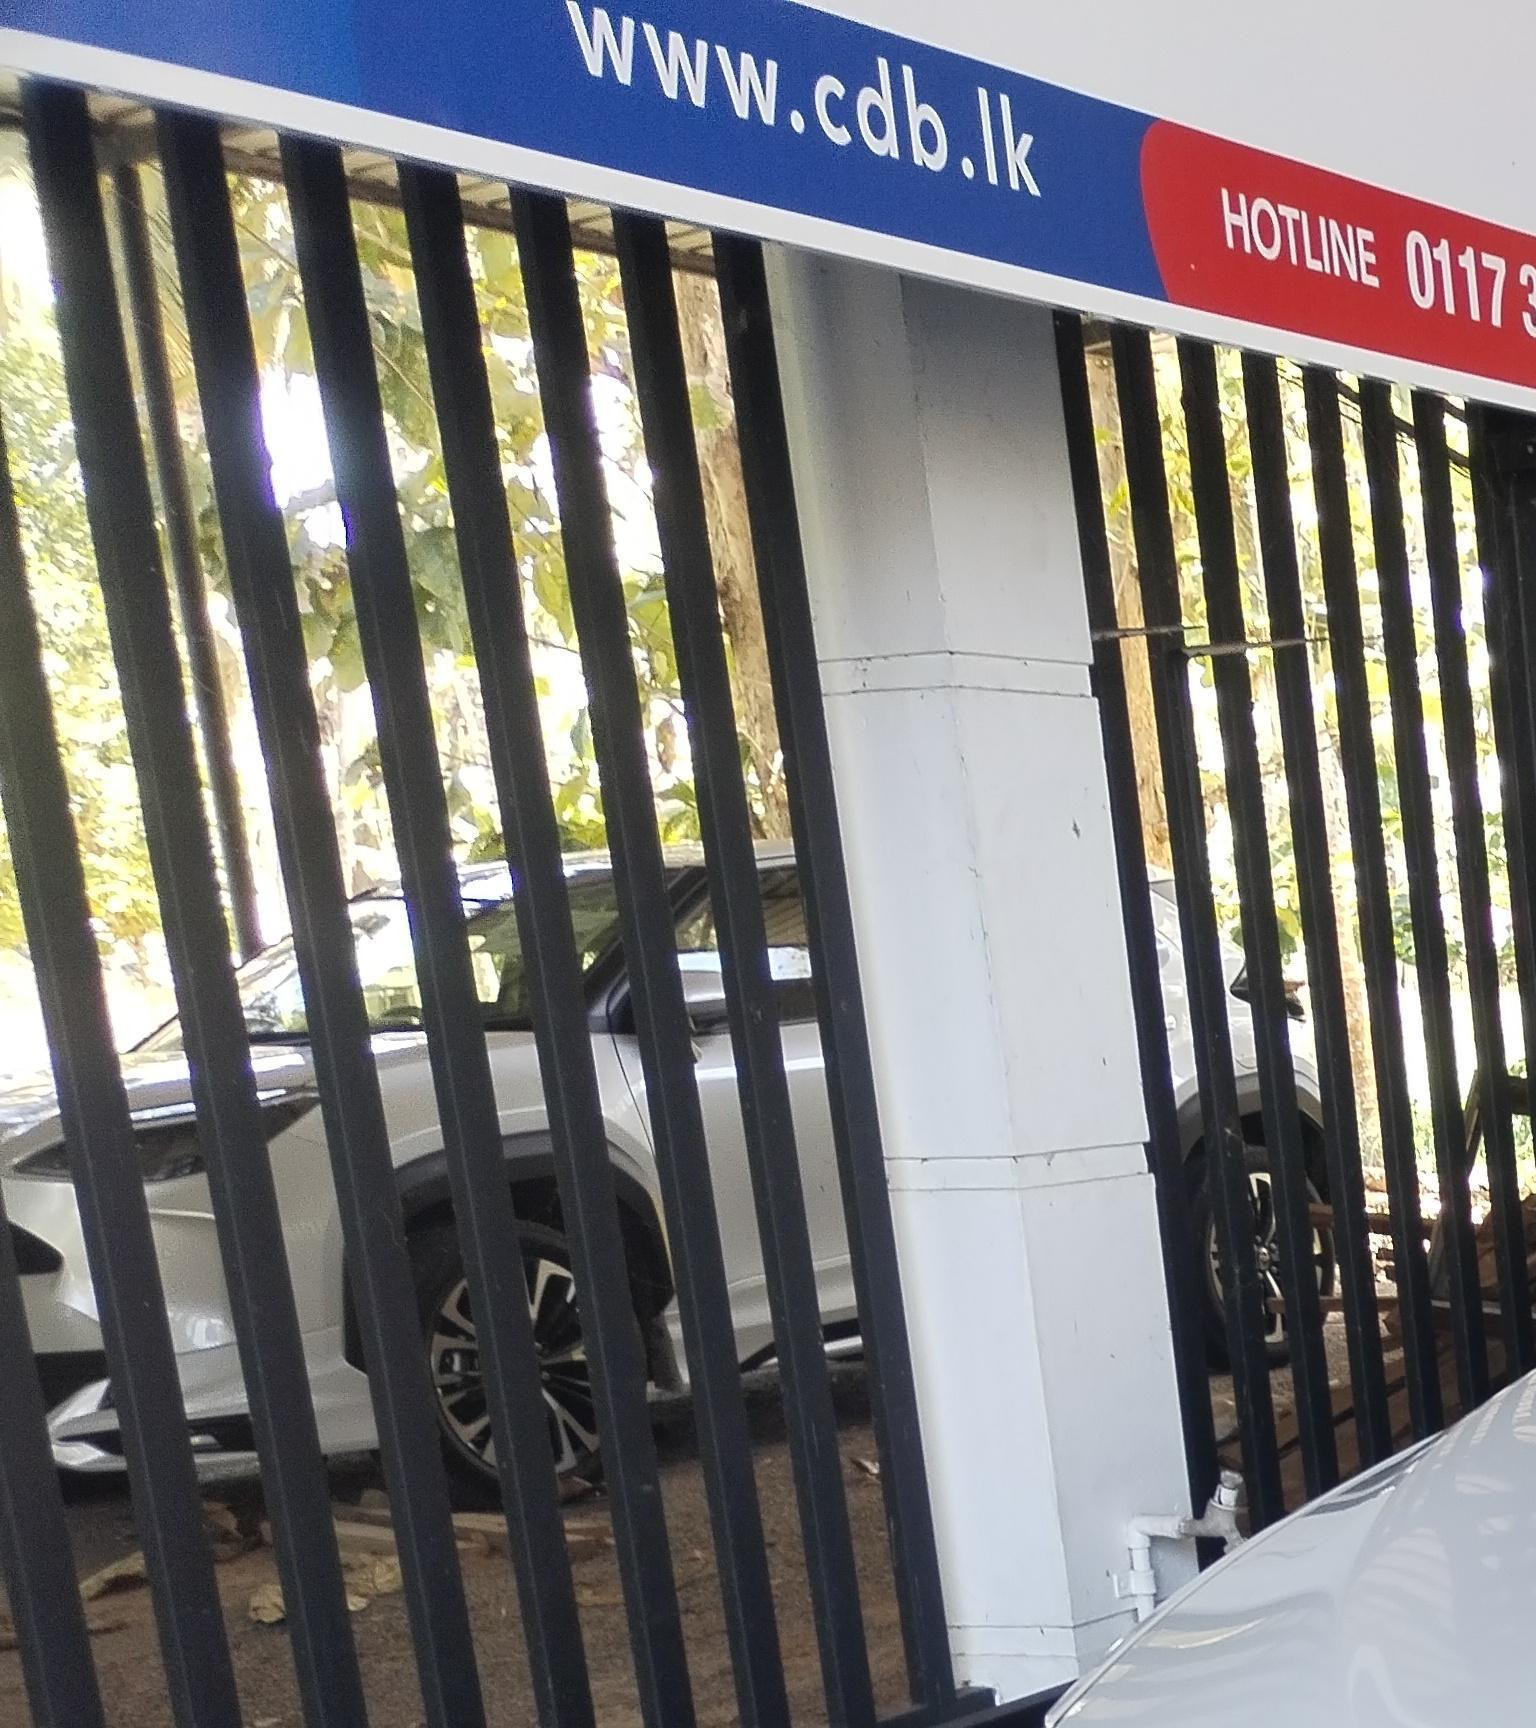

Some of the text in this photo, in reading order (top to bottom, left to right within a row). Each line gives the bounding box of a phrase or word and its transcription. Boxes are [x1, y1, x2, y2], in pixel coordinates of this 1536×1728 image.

[565, 0, 1041, 198] www.cdb.lk
[1221, 187, 1380, 289] HOTLINE
[1406, 230, 1506, 328] 0117
